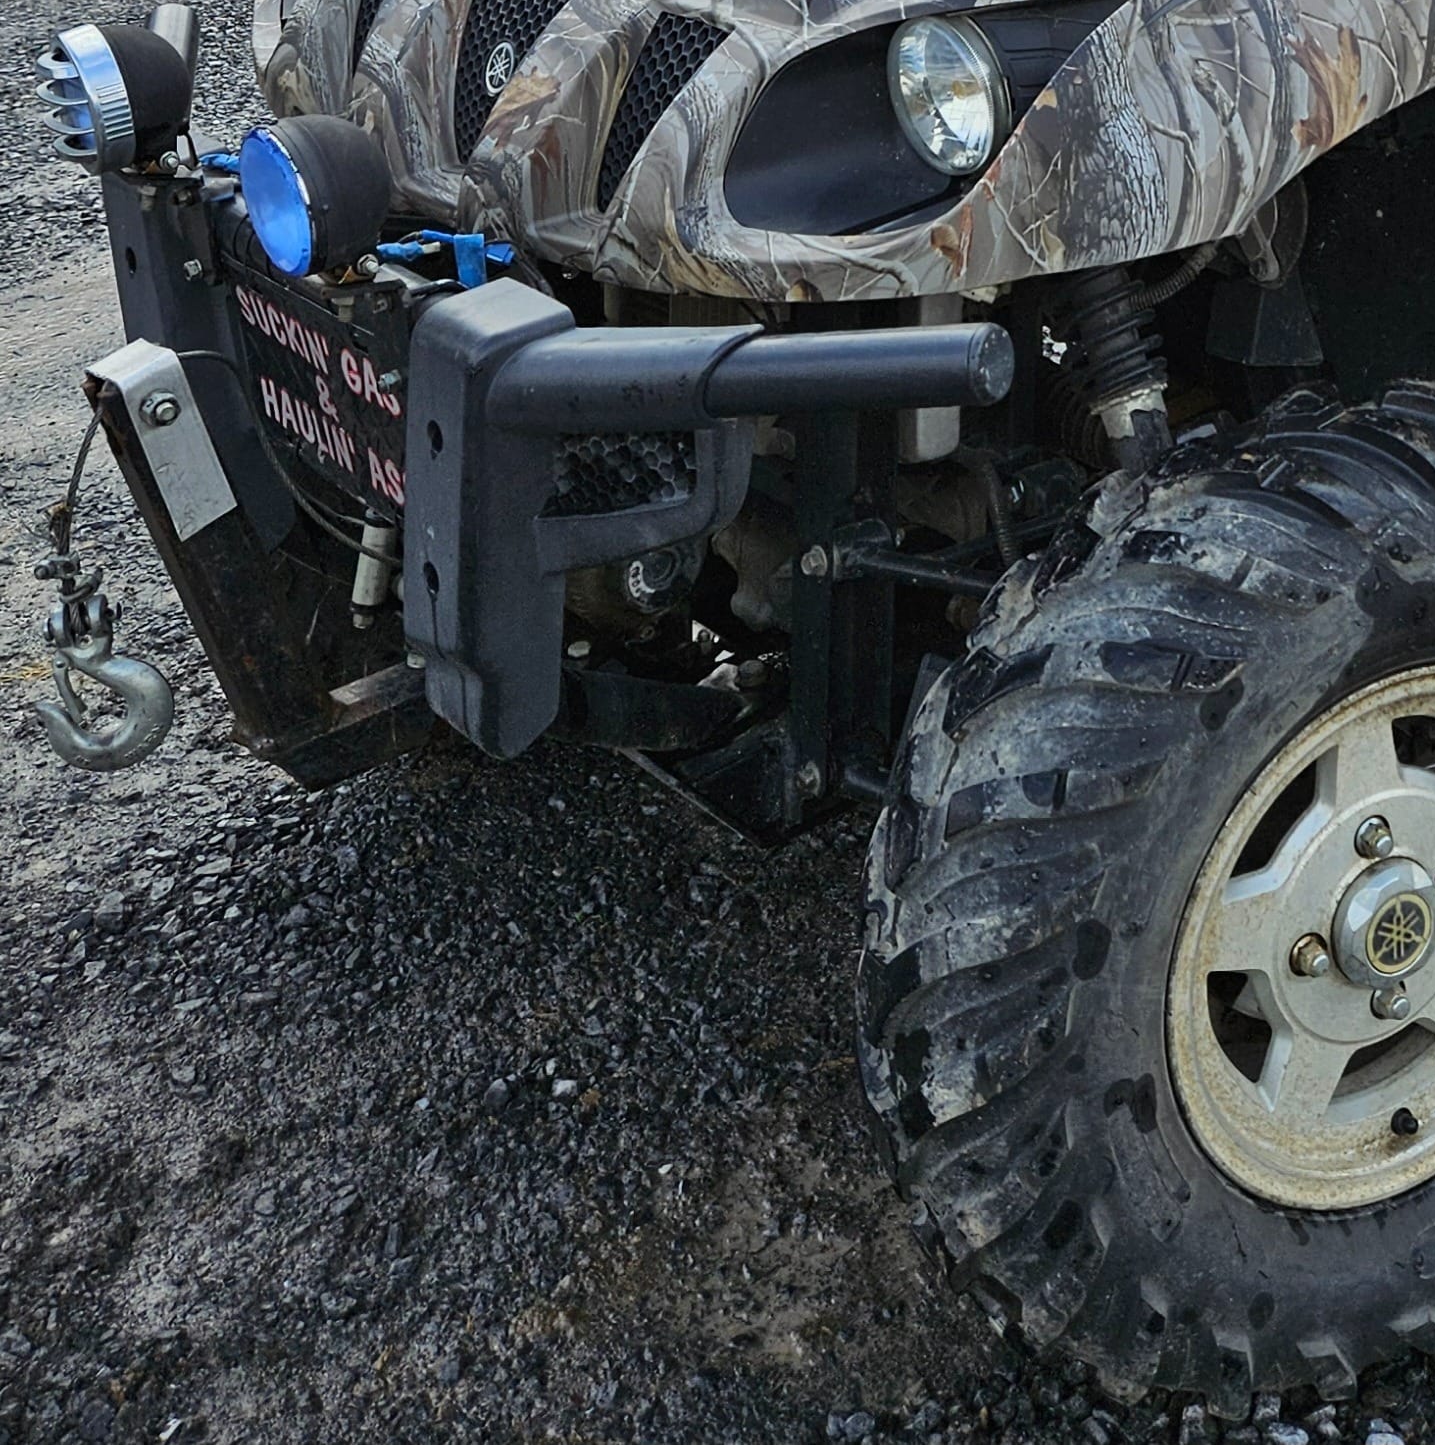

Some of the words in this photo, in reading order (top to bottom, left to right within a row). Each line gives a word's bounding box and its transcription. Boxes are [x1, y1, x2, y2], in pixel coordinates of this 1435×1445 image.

[235, 284, 329, 375] SUCKIN'
[260, 375, 356, 473] HAULIN'
[368, 446, 406, 505] AS
[315, 374, 340, 422] &
